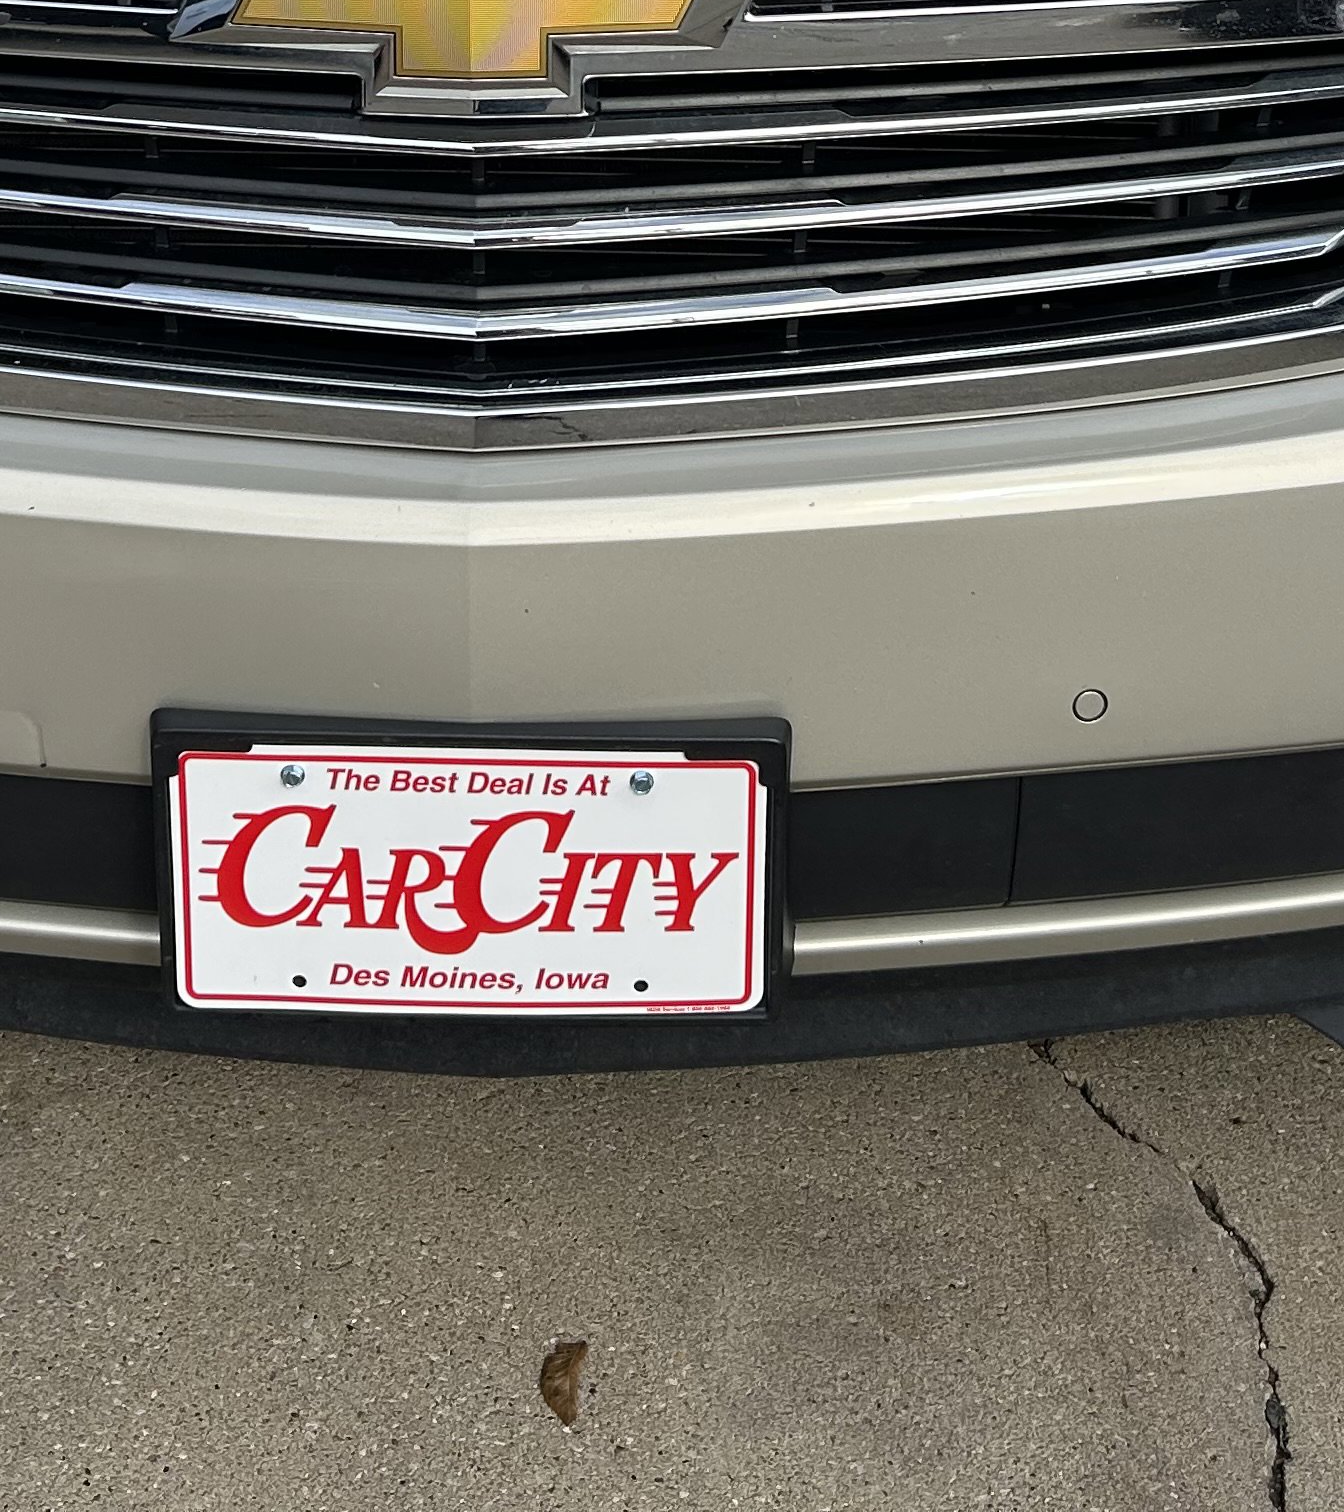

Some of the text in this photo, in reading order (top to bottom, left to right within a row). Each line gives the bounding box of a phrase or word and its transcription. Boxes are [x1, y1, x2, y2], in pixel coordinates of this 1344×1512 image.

[326, 767, 611, 797] The Best Deal Is At
[329, 962, 611, 995] Des Moines, Iowa
